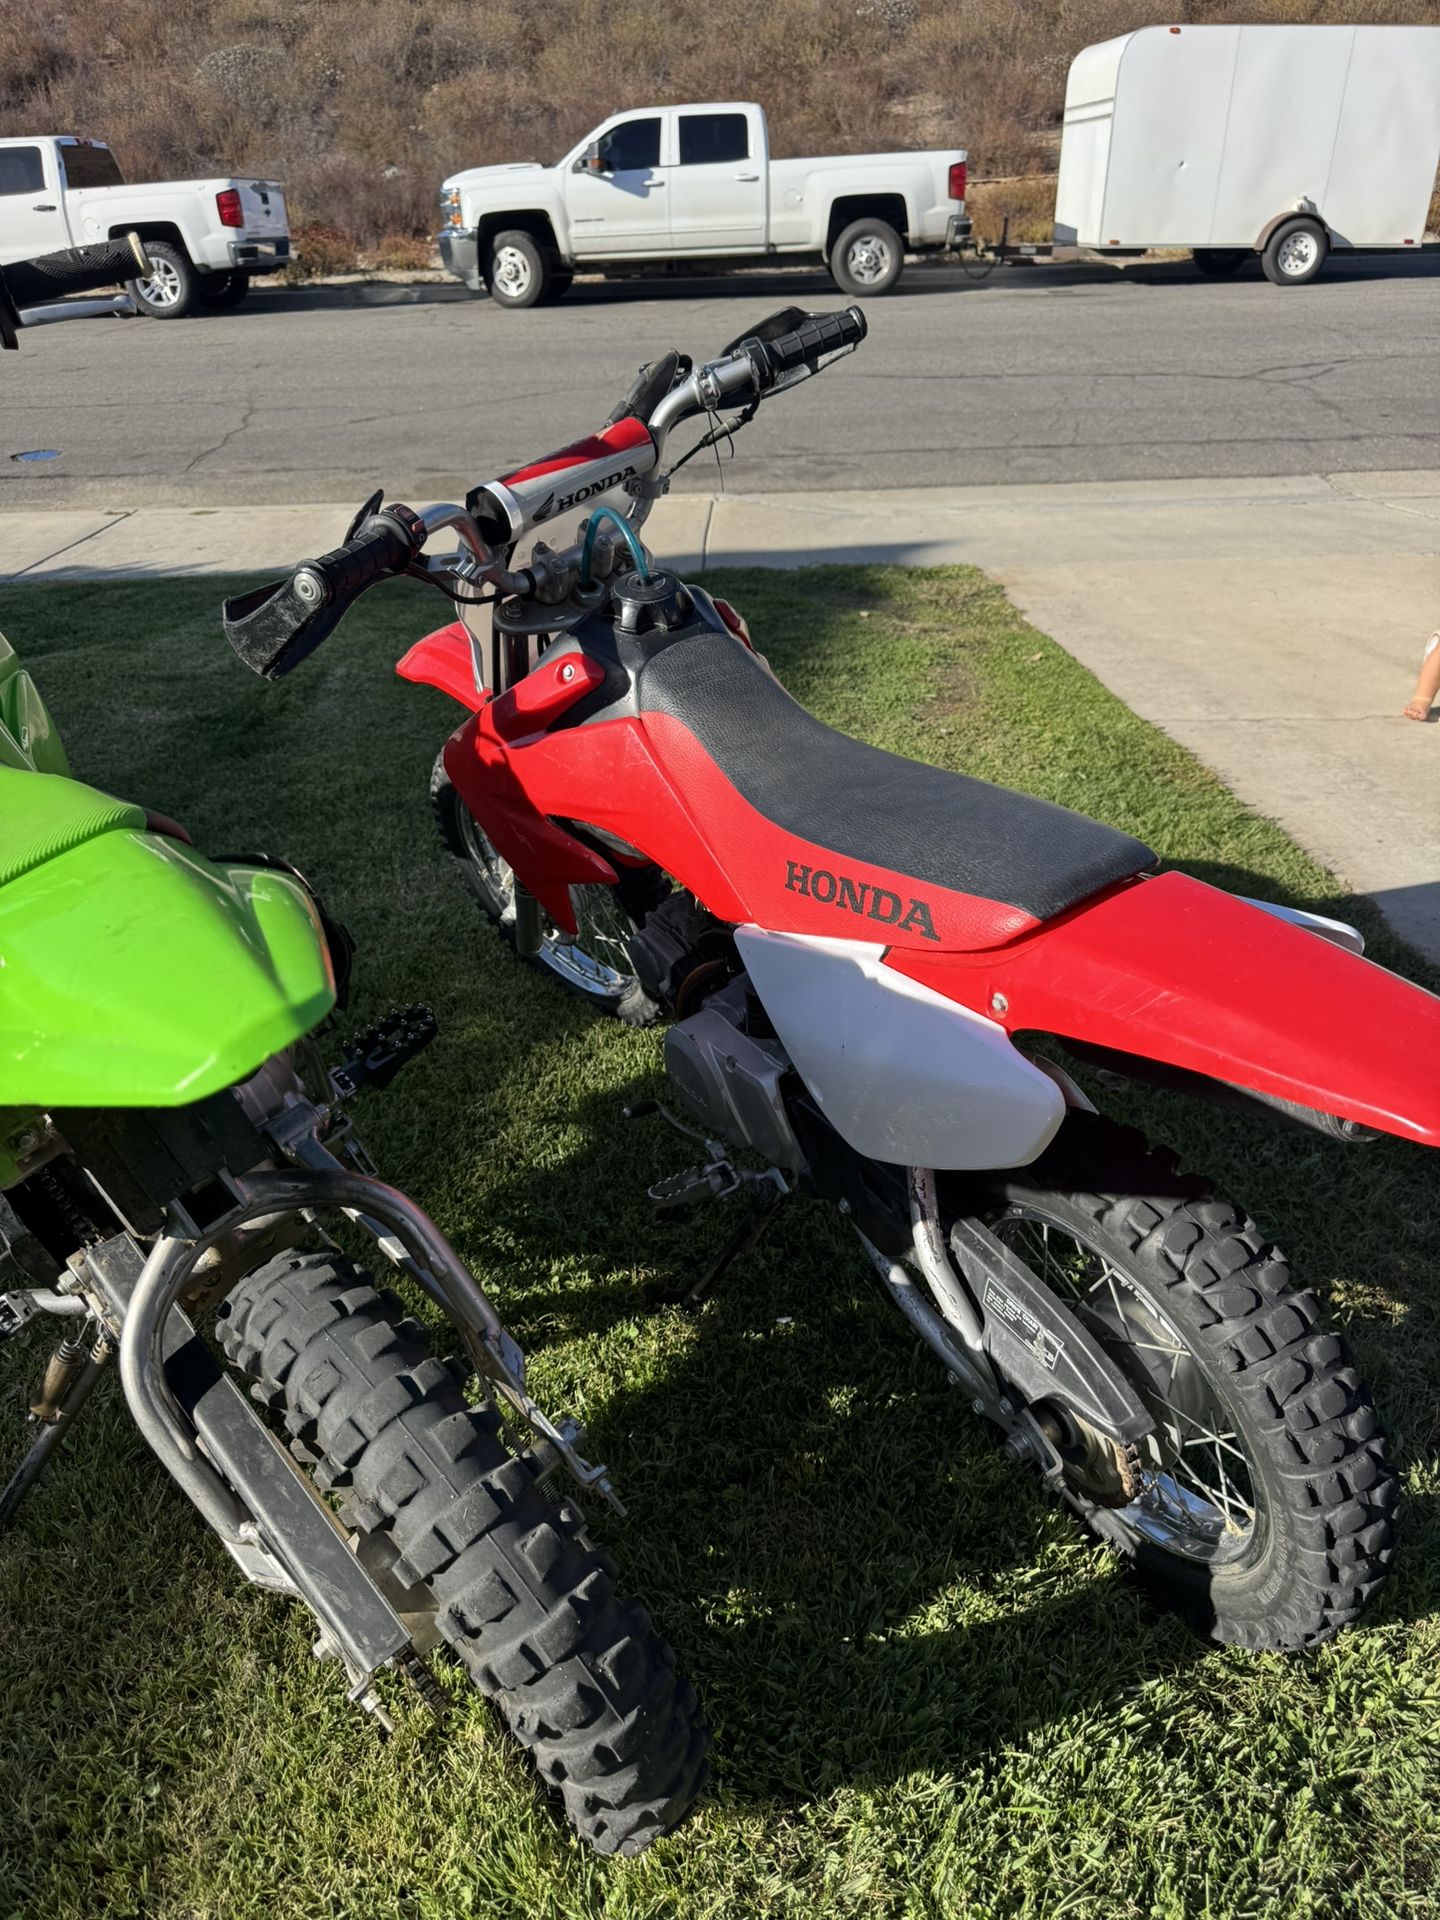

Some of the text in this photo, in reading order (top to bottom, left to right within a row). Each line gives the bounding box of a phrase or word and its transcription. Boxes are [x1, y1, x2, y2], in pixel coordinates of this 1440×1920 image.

[557, 466, 637, 512] HONDA
[785, 860, 941, 942] HONDA
[1022, 1313, 1039, 1330] CHAIN
